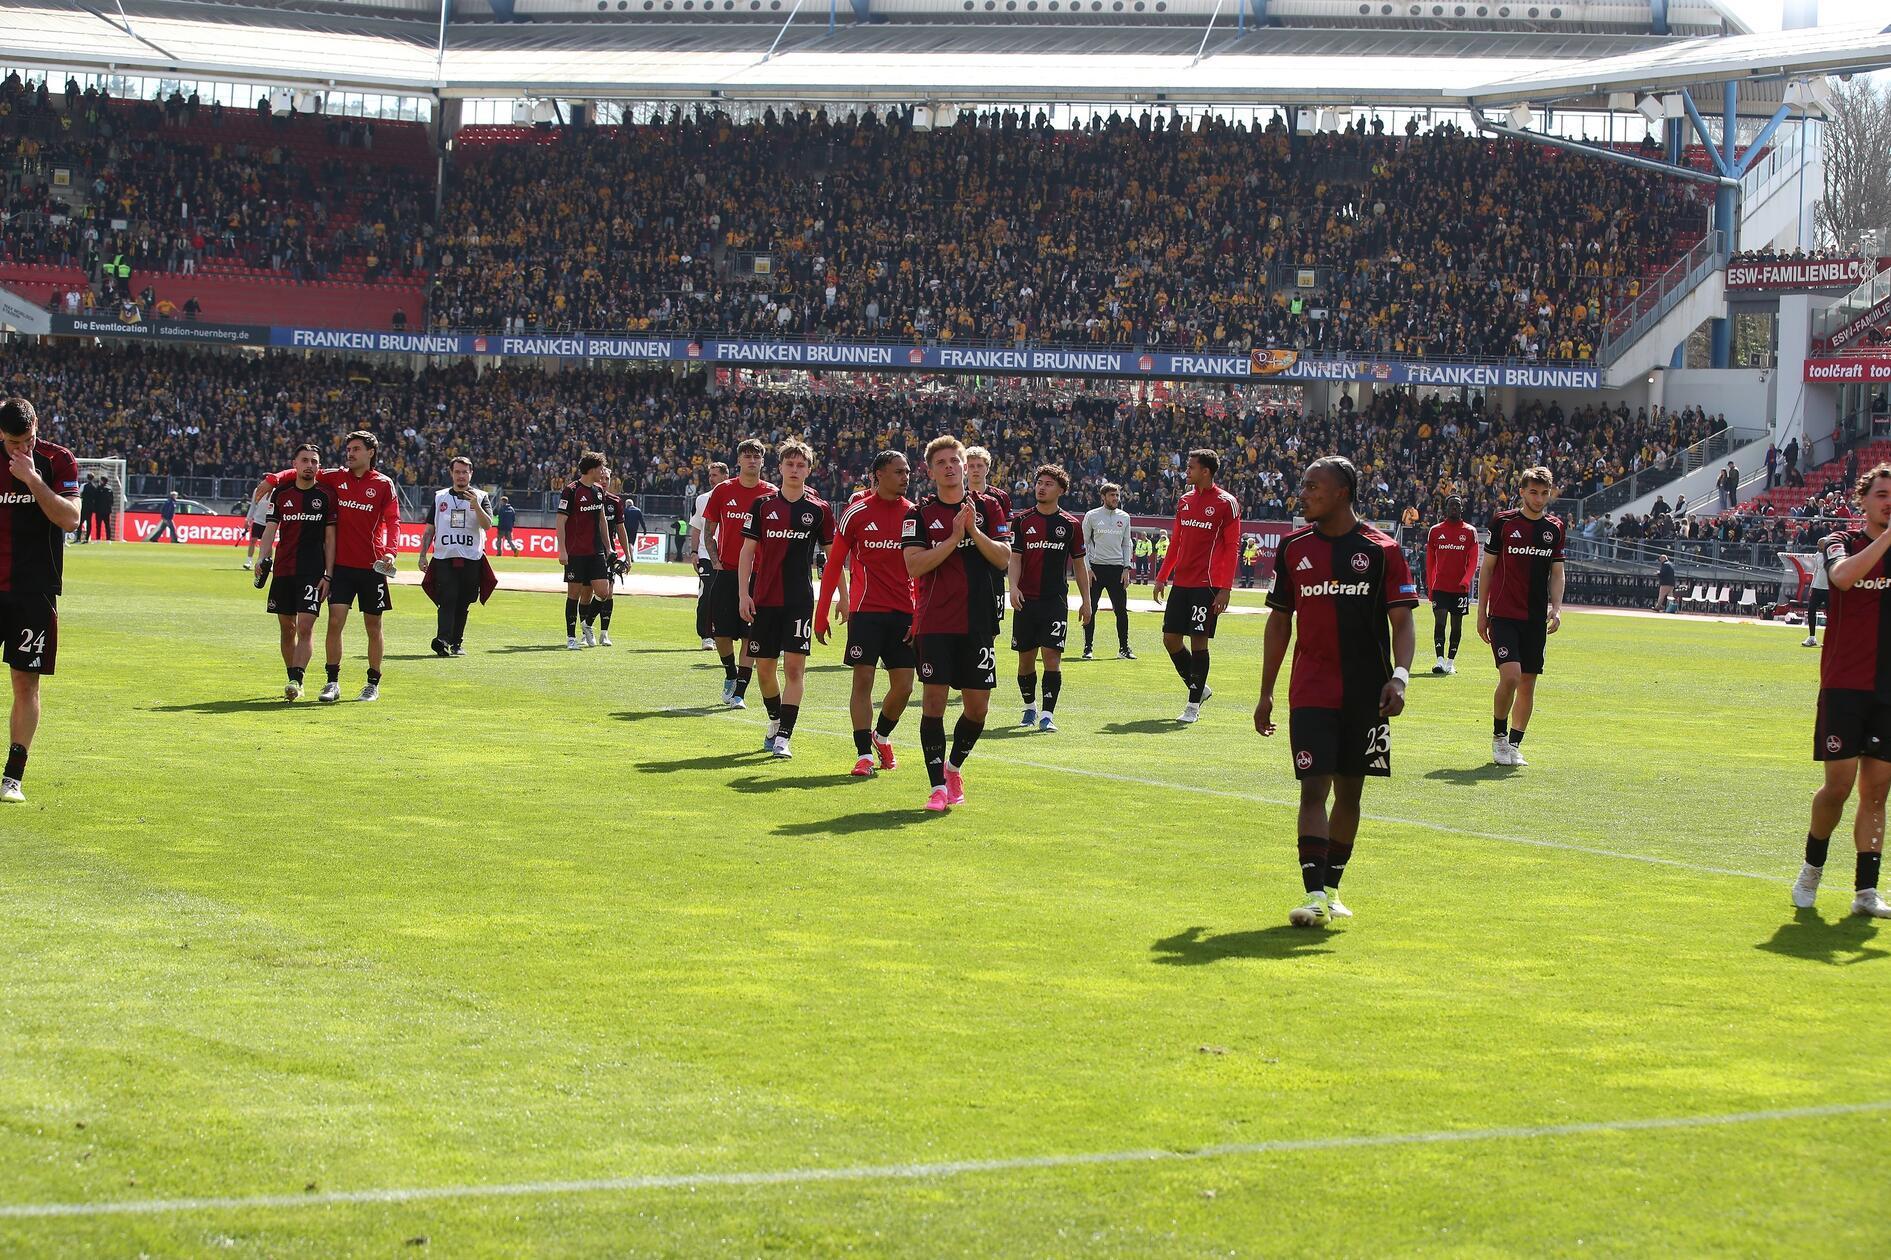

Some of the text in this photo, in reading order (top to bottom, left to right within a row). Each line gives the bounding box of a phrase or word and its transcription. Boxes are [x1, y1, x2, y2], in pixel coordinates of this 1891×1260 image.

[74, 320, 250, 341] Die Eventlocation stadion-nuernberg.de
[293, 330, 458, 352] FRANKEN BRUNNEN
[503, 338, 670, 357] FRANKEN BRUNNEN
[718, 343, 891, 363] FRANKEN BRUNNEN
[940, 350, 1120, 370] FRANKEN BRUNNEN
[1171, 357, 1251, 375] FRANKE
[1407, 364, 1597, 388] FRANKEN BRUNNEN
[441, 535, 474, 547] CLUB
[303, 584, 320, 603] 21
[377, 583, 385, 601] 5
[1457, 597, 1469, 608] 22
[1191, 605, 1207, 623] 28
[793, 618, 811, 639] 16
[1050, 620, 1067, 637] 27
[18, 628, 46, 654] 24
[977, 647, 996, 671] 25
[1364, 723, 1390, 755] 23
